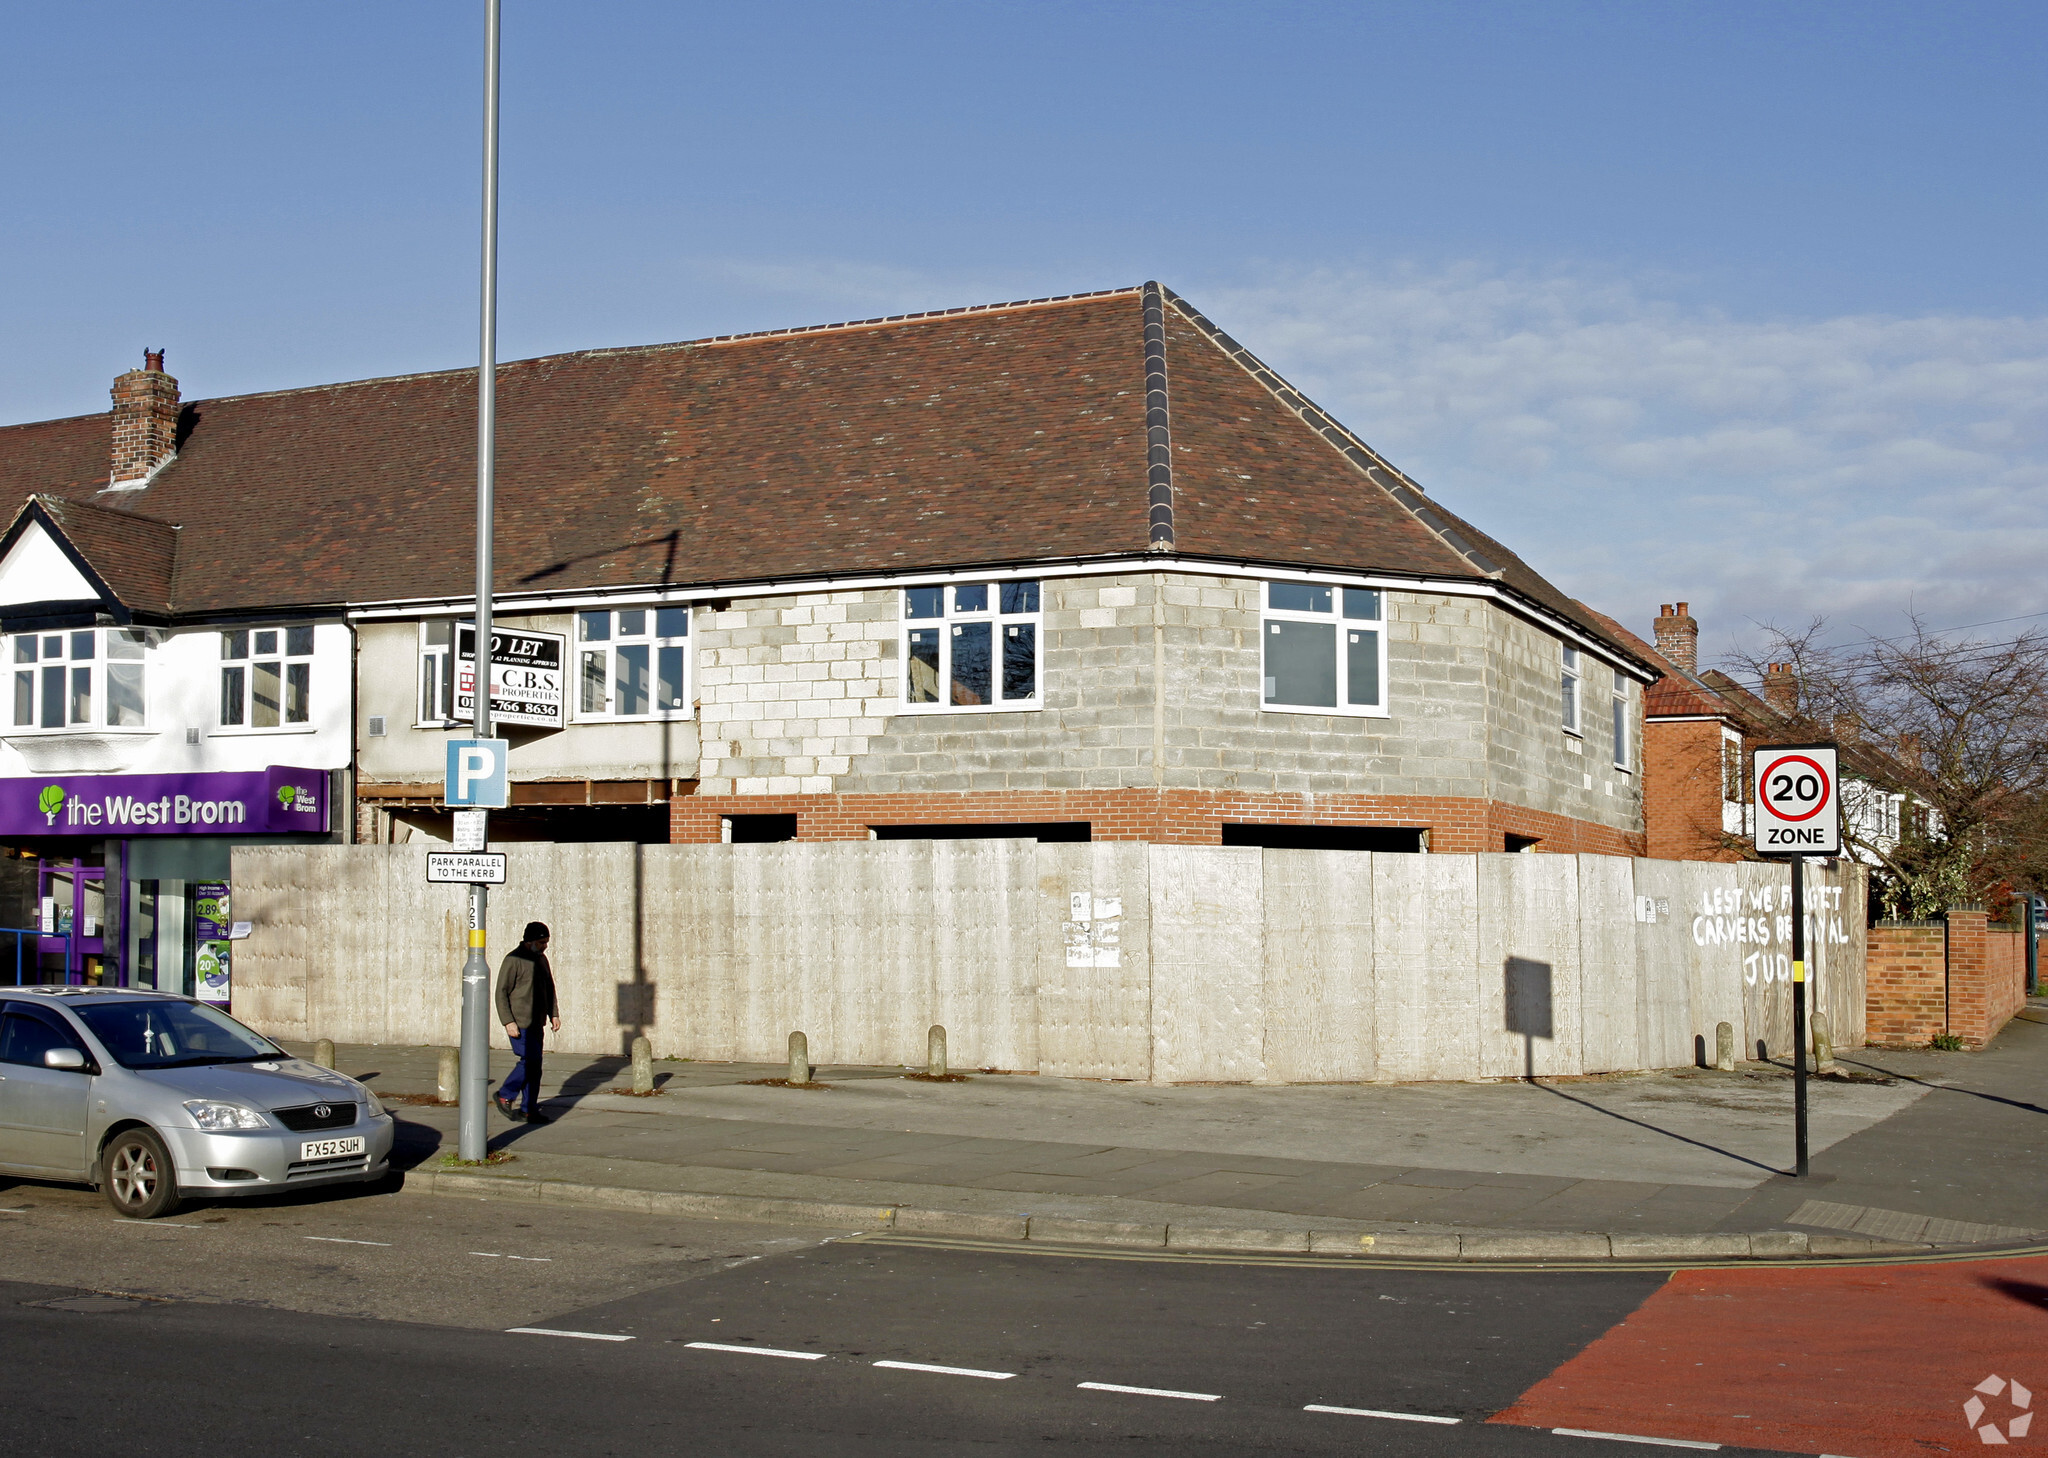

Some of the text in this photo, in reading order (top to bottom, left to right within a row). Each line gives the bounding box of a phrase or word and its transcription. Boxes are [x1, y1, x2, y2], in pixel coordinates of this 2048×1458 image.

[508, 638, 544, 656] LET
[503, 656, 531, 664] PLANNING
[502, 669, 560, 691] C.B.S.
[502, 687, 560, 701] PROPERTIES
[525, 702, 556, 715] 8636
[457, 746, 495, 800] P
[296, 786, 308, 796] the
[1772, 774, 1819, 801] 20
[296, 795, 316, 805] West
[296, 803, 317, 813] Brom
[67, 795, 245, 826] the West Brom
[1768, 828, 1825, 844] ZONE
[431, 858, 501, 867] PARK PARALLEL
[437, 868, 495, 878] TO THE KERB
[1703, 885, 1842, 916] LEST WE FGET
[1692, 914, 1849, 947] CARVERS BERAYAL
[1744, 951, 1814, 987] JUDS
[306, 1139, 359, 1157] FX52 SUH
